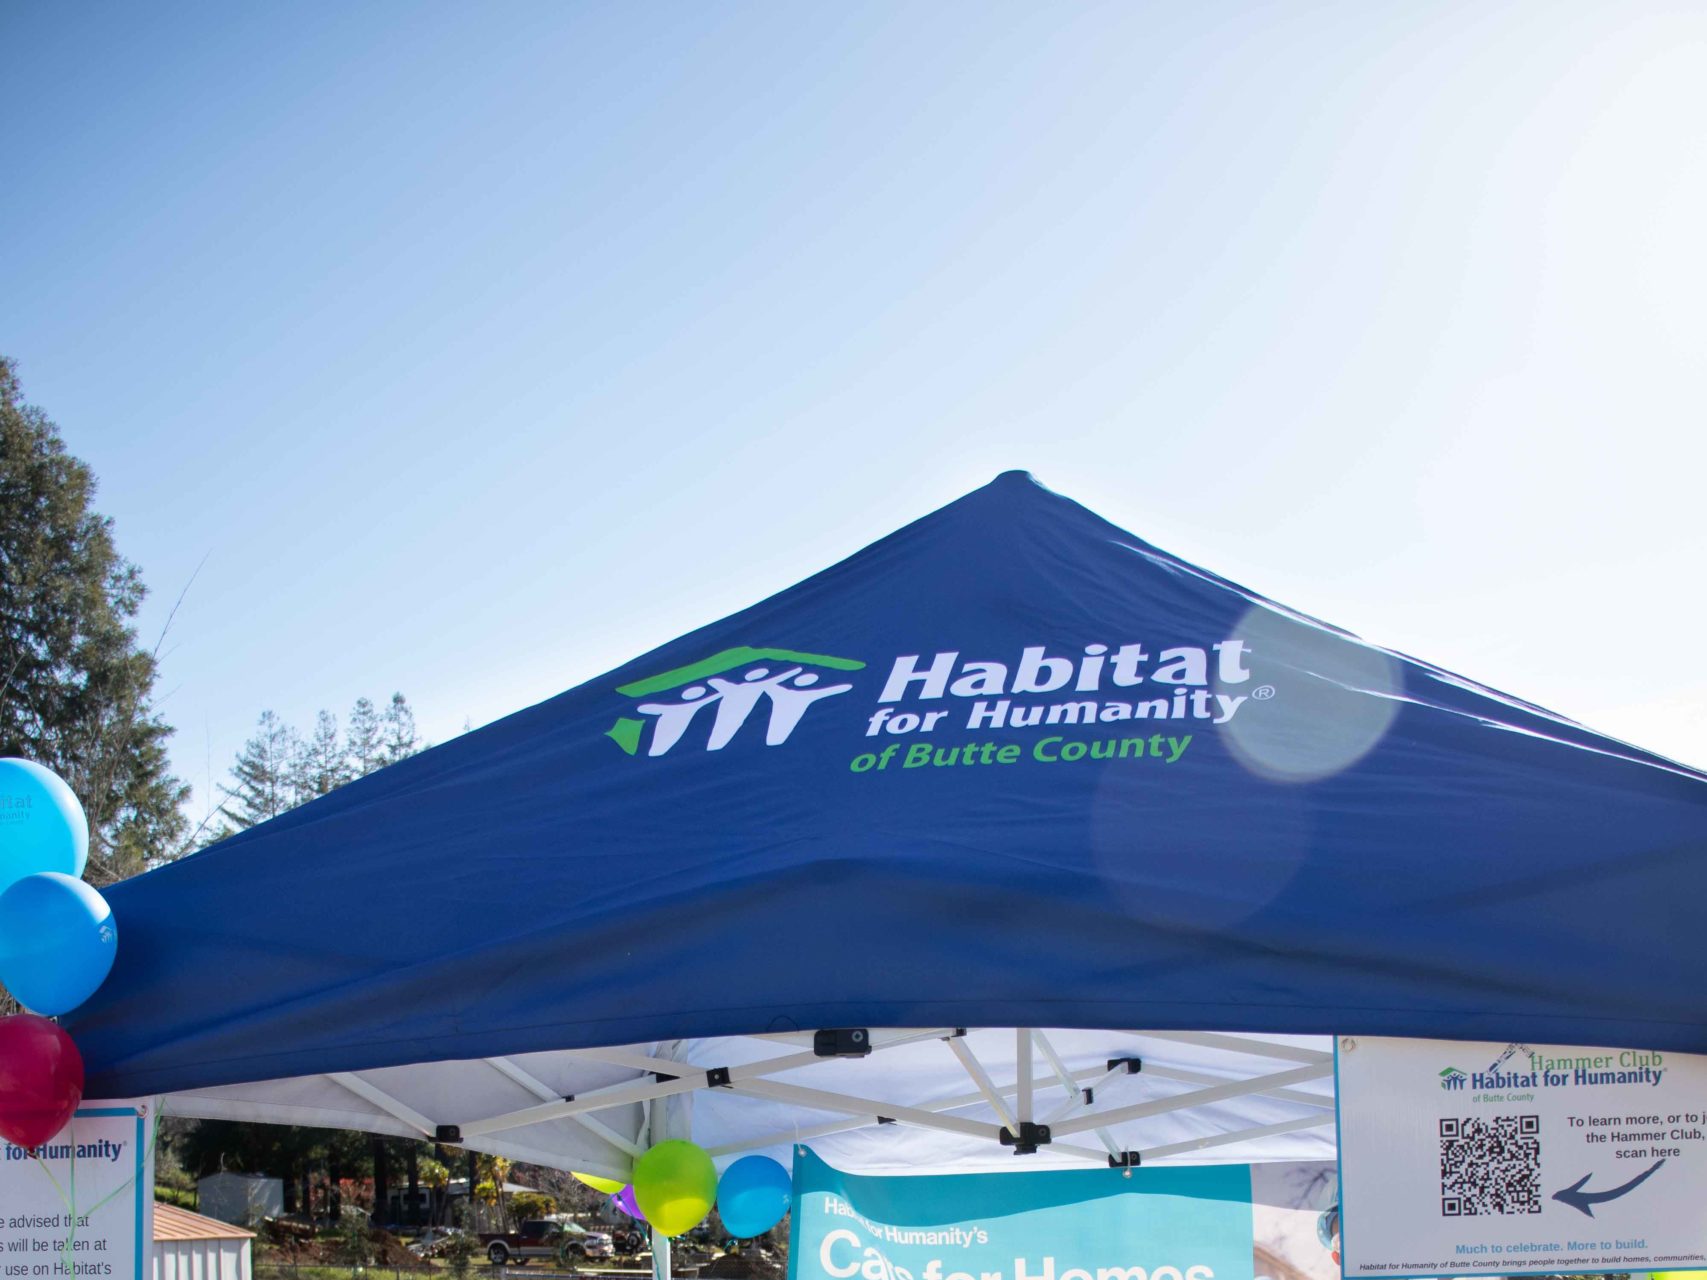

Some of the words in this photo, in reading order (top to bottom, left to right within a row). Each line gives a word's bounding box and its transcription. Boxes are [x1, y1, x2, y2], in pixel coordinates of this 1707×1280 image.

[877, 640, 1252, 703] Habitat
[866, 707, 947, 736] for
[850, 743, 898, 773] of
[902, 740, 1020, 768] Butte
[1033, 735, 1192, 766] County
[1530, 1055, 1613, 1071] Hammer
[1619, 1051, 1664, 1068] Club
[1472, 1070, 1538, 1089] Habitat
[1543, 1069, 1569, 1087] for
[1574, 1067, 1663, 1087] Humanity
[1472, 1095, 1481, 1103] of
[1483, 1094, 1504, 1103] Butte
[1507, 1092, 1535, 1103] County
[1568, 1116, 1584, 1127] To
[1588, 1115, 1621, 1126] learn
[1625, 1115, 1663, 1126] more,
[1667, 1115, 1681, 1124] or
[1685, 1112, 1698, 1123] to
[1586, 1132, 1607, 1143] the
[1611, 1131, 1667, 1142] Hammer
[1670, 1128, 1705, 1141] Club,
[1616, 1148, 1647, 1159] scan
[1651, 1147, 1680, 1157] here
[9, 1214, 59, 1228] advised
[64, 1214, 89, 1228] that
[8, 1239, 28, 1252] will
[32, 1239, 49, 1252] be
[53, 1238, 89, 1251] taken
[94, 1239, 107, 1251] at
[885, 1226, 988, 1249] Humanity's
[1456, 1244, 1488, 1254] Much
[1492, 1244, 1503, 1253] to
[1506, 1242, 1564, 1253] celebrate.
[1567, 1241, 1597, 1251] More
[1600, 1241, 1612, 1250] to
[1615, 1239, 1649, 1250] build.
[5, 1264, 28, 1276] use
[33, 1263, 49, 1275] on
[54, 1262, 112, 1275] Habitat's
[1359, 1263, 1387, 1271] Habitat
[1401, 1262, 1438, 1270] Humanity
[1472, 1260, 1500, 1268] County
[1502, 1259, 1527, 1267] brings
[1529, 1258, 1555, 1266] people
[1557, 1257, 1589, 1266] together
[1623, 1255, 1651, 1263] homes,
[1653, 1253, 1706, 1262] communities,
